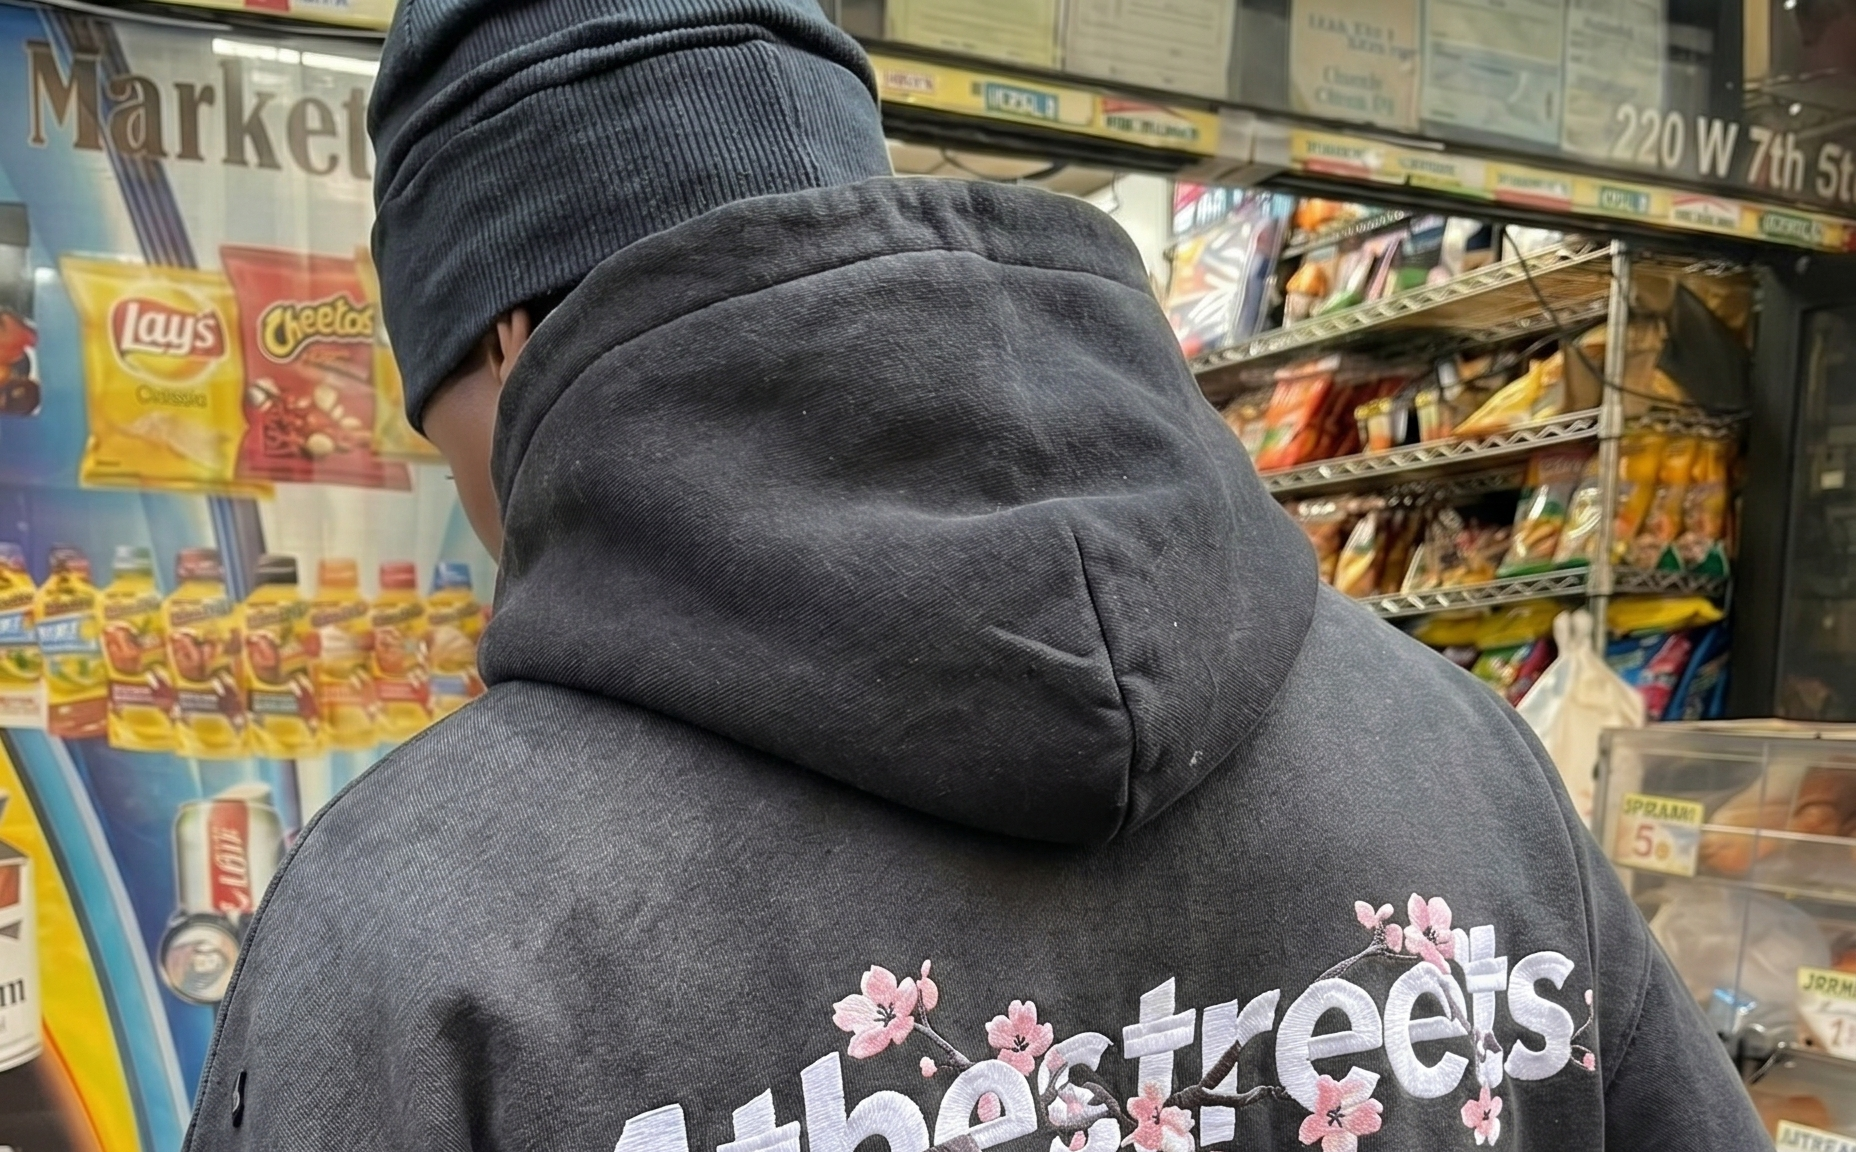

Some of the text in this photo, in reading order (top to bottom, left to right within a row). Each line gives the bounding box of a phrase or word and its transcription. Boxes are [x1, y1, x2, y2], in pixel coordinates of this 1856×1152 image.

[25, 38, 372, 181] Market
[1609, 103, 1856, 204] 220 W 7th St
